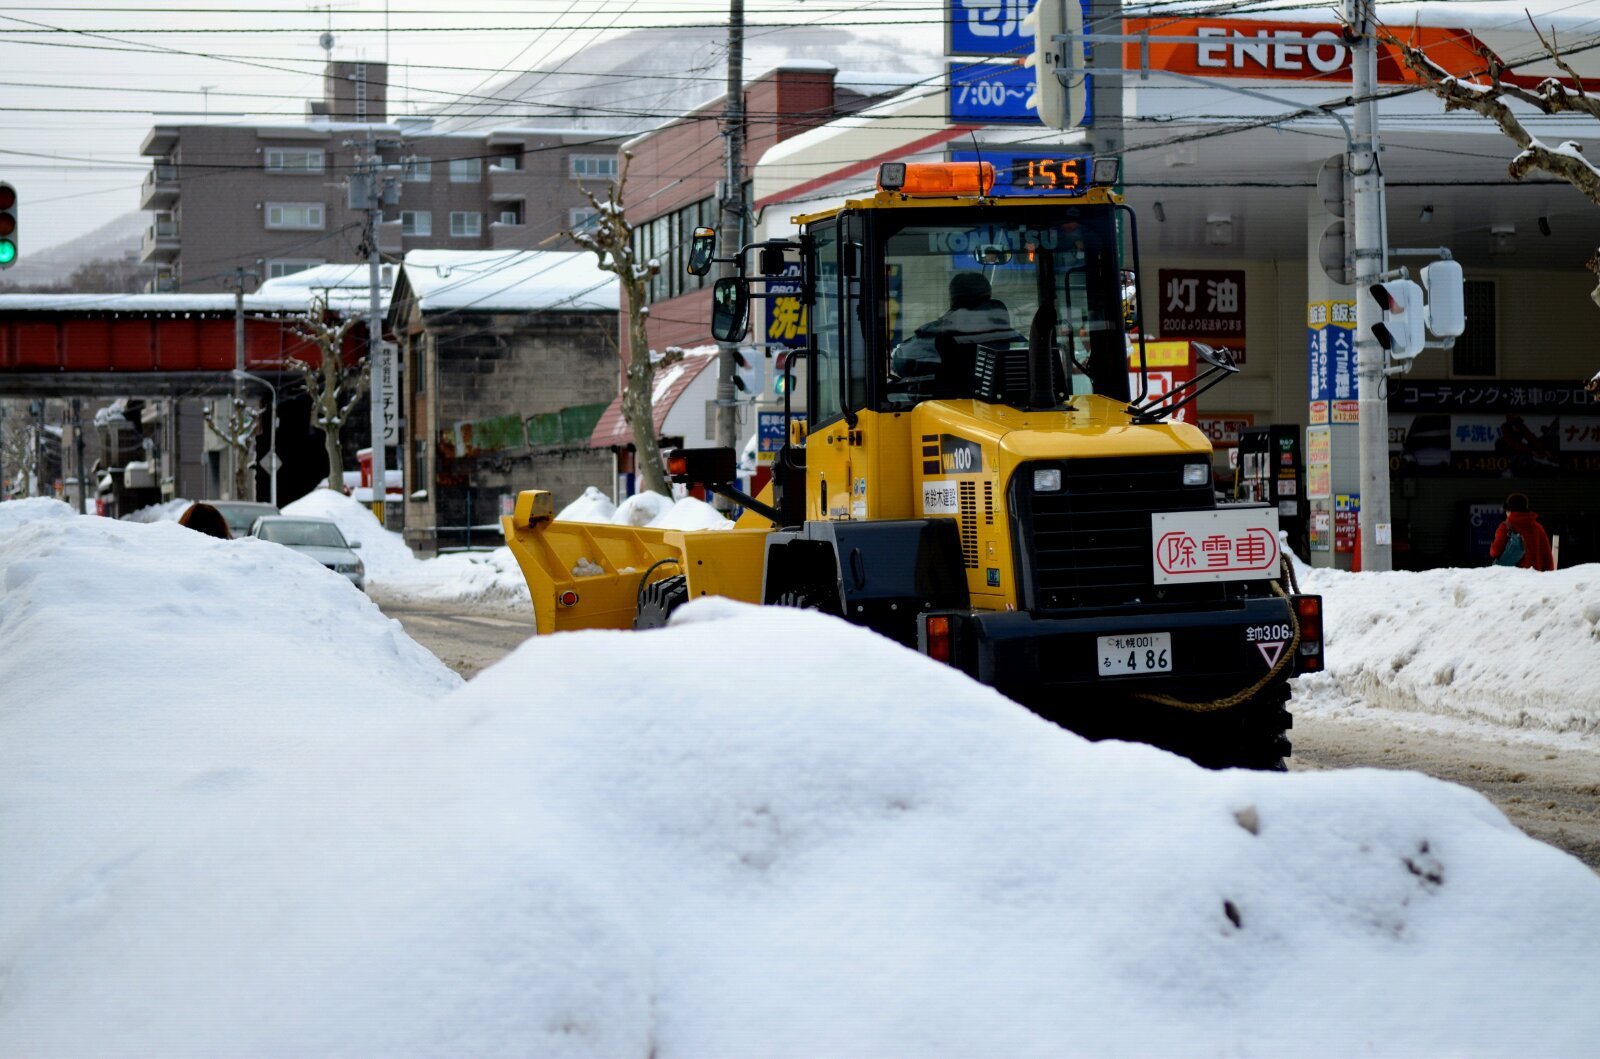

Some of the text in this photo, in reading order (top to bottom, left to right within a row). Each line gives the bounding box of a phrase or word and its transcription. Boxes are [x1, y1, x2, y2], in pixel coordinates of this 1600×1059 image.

[1196, 26, 1354, 72] ENEO
[1028, 159, 1079, 189] 155
[1167, 277, 1239, 313] 灯油
[1403, 384, 1600, 407] コーティング・洗車のプロ
[942, 447, 972, 470] WA100
[1168, 531, 1267, 569] 除雪車
